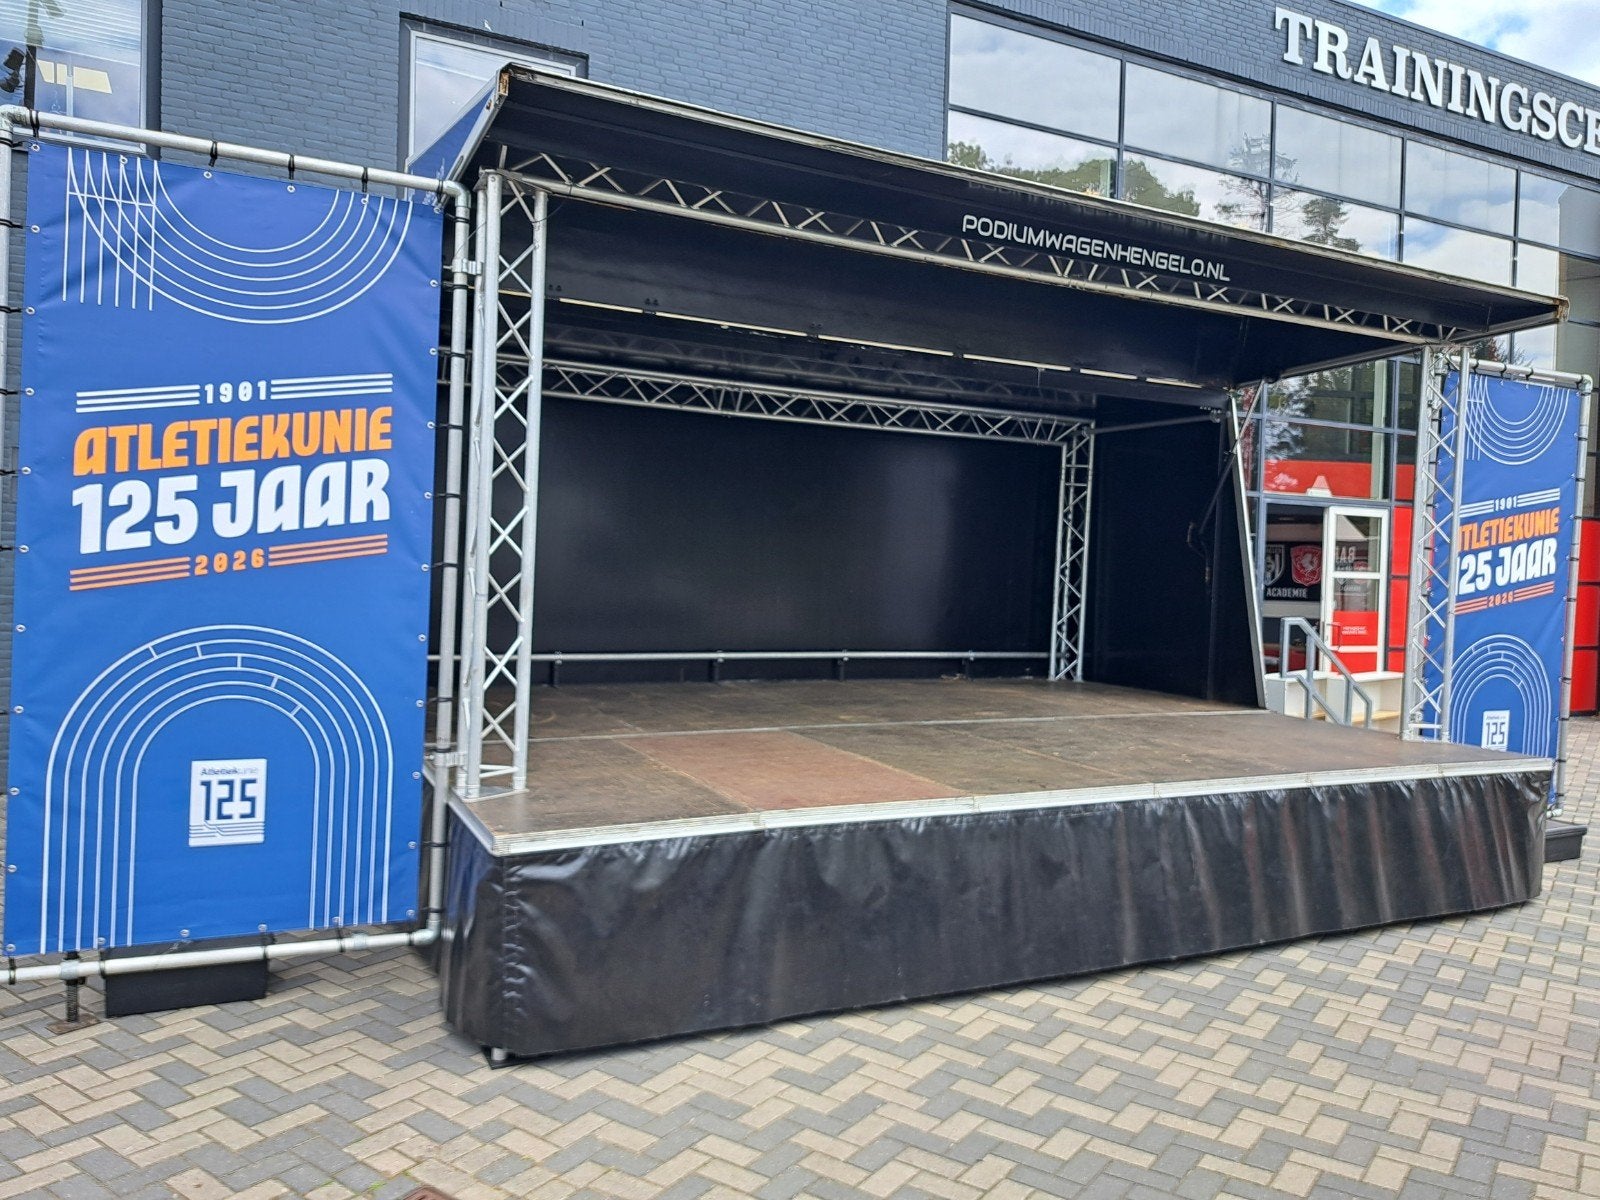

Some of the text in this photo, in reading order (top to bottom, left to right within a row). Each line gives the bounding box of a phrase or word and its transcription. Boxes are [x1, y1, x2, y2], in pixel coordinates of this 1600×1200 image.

[962, 214, 1231, 282] PODIUMWAGENHENGELO.NL
[204, 380, 267, 404] 1901
[73, 406, 393, 476] ATLETIEKUNIE
[72, 458, 391, 555] 125 JAAR
[1494, 495, 1517, 511] 1901
[194, 548, 264, 576] 2026
[1495, 537, 1558, 587] JAAR
[1266, 587, 1308, 599] ACADEMIE
[1488, 591, 1514, 607] 2026
[1486, 721, 1506, 746] 125
[200, 778, 257, 820] 125
